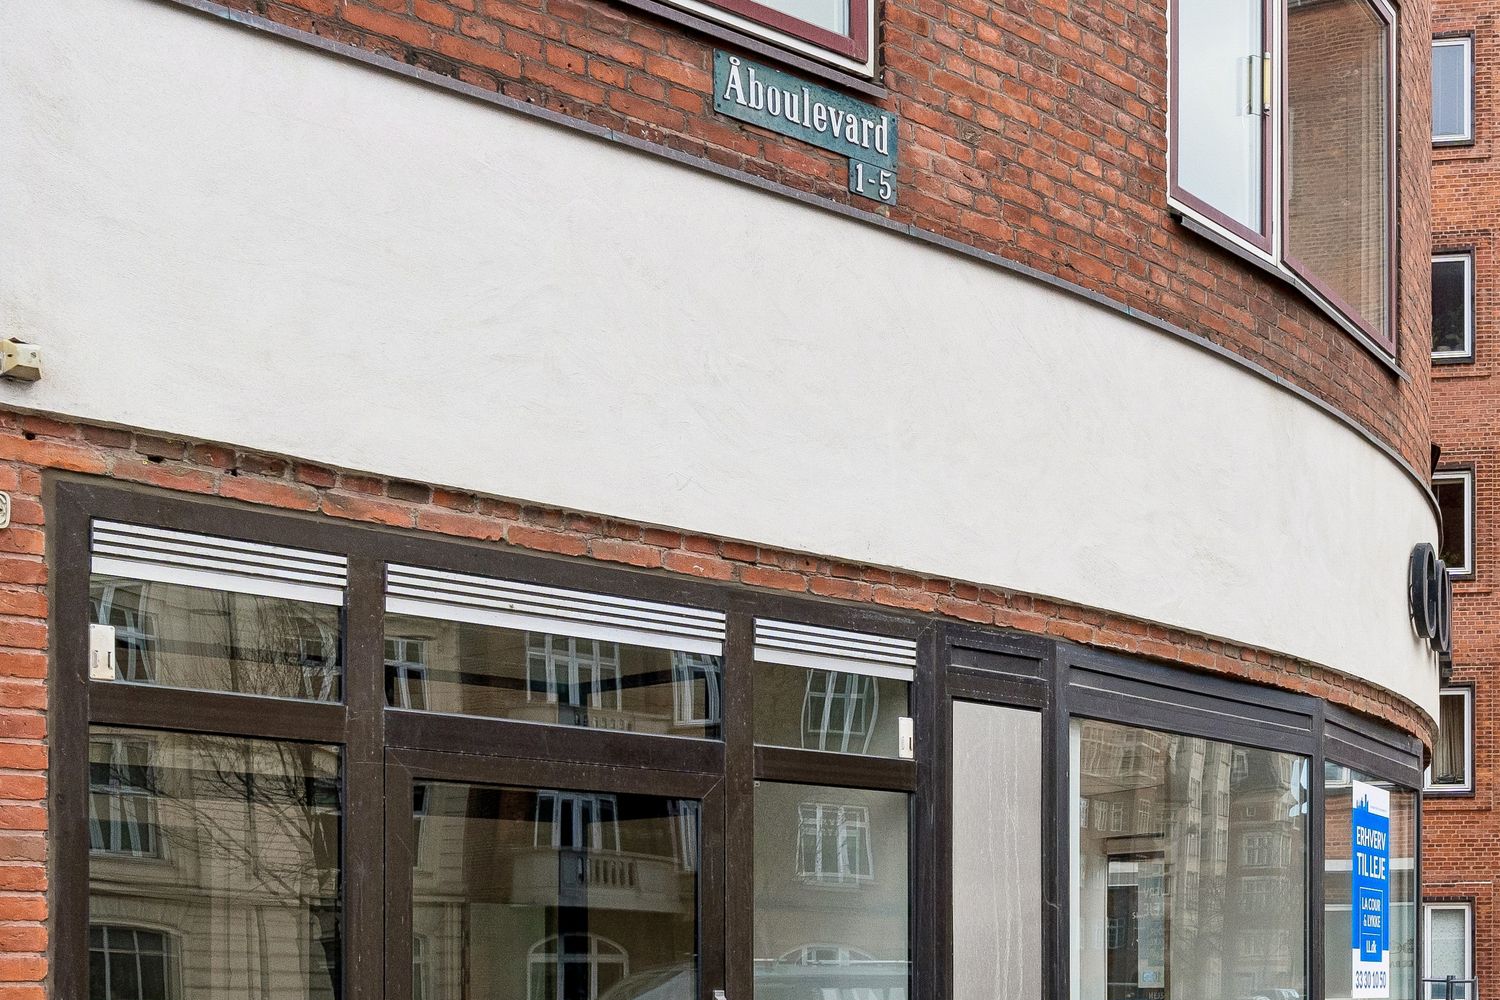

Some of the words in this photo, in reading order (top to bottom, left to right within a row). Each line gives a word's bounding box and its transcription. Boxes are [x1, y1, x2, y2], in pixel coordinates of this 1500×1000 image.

[723, 56, 889, 156] Åboulevard
[855, 163, 892, 200] 1-5
[1356, 825, 1387, 851] ERHVERV
[1356, 852, 1369, 877] TIL
[1369, 855, 1386, 880] LEJE
[1361, 897, 1369, 911] LA
[1368, 898, 1381, 912] COUR
[1355, 970, 1363, 988] 33
[1363, 970, 1372, 989] 30
